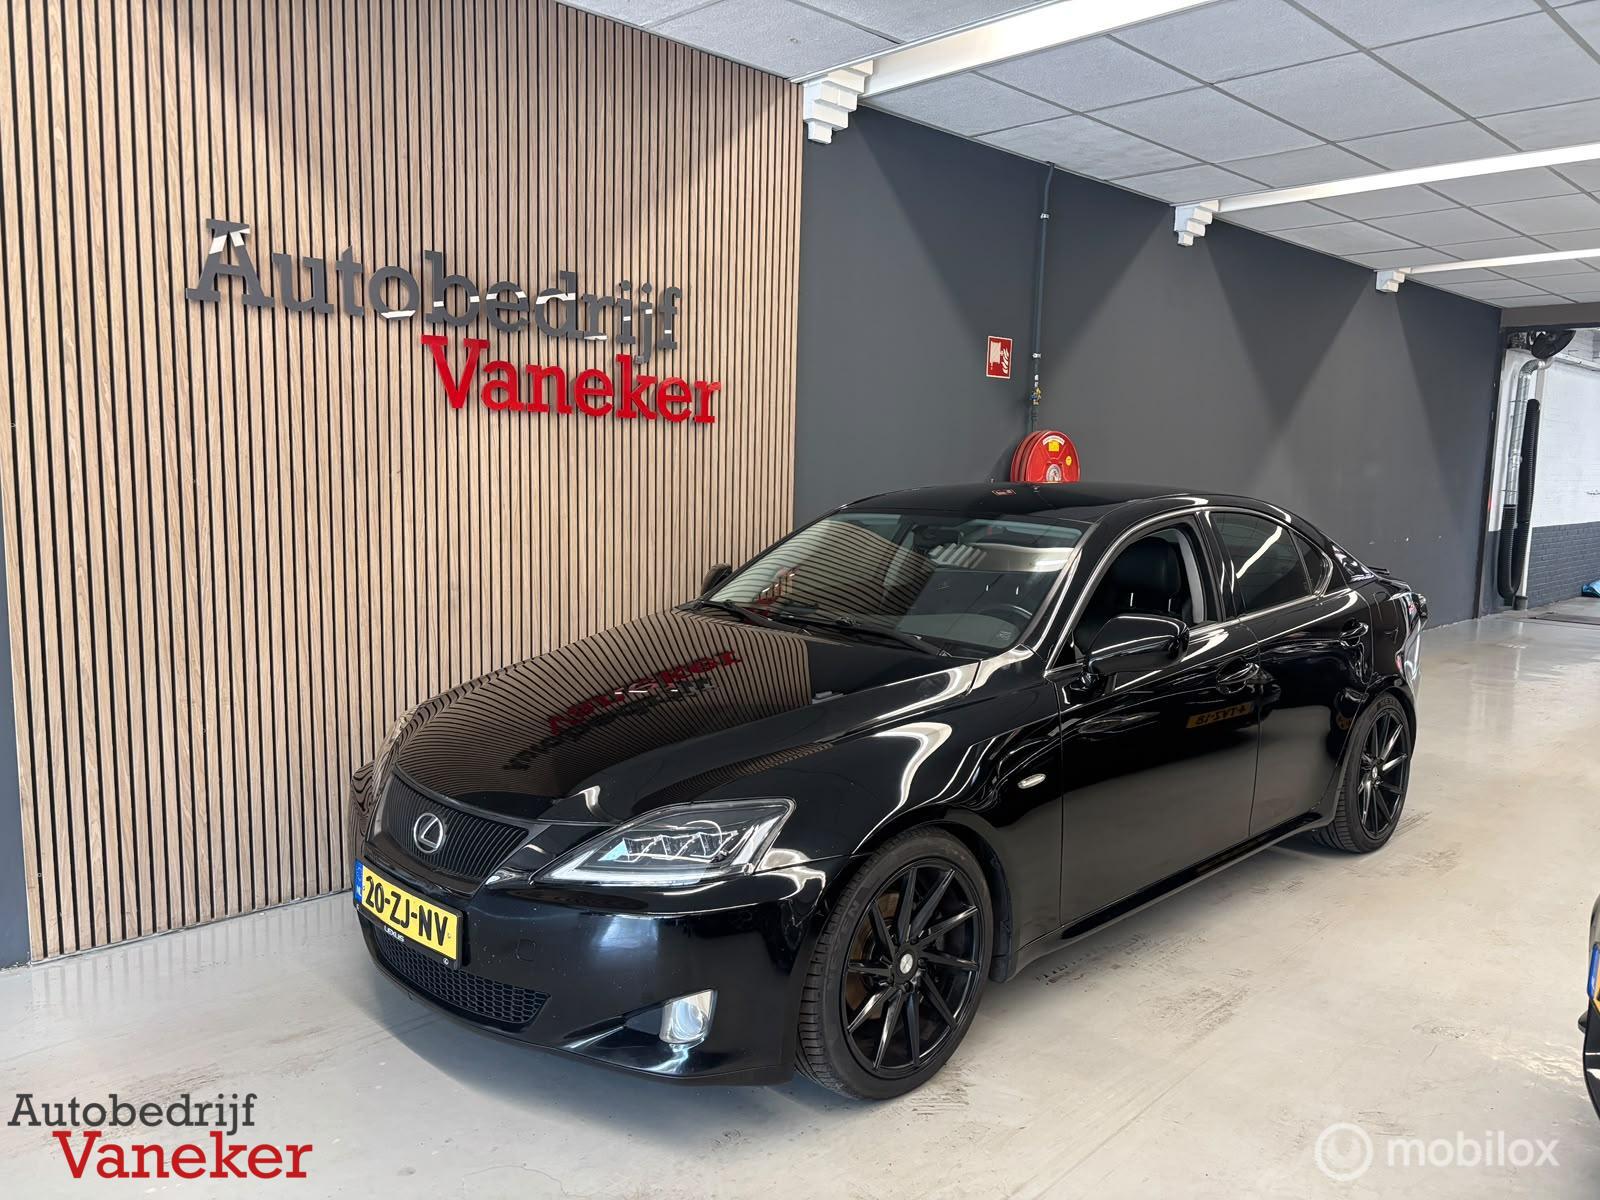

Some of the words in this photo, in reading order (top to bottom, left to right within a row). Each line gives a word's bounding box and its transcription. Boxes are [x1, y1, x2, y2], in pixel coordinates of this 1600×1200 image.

[186, 218, 681, 365] Autobedrijf
[421, 333, 721, 424] Vaneker
[366, 876, 448, 946] 20-ZJ-NV
